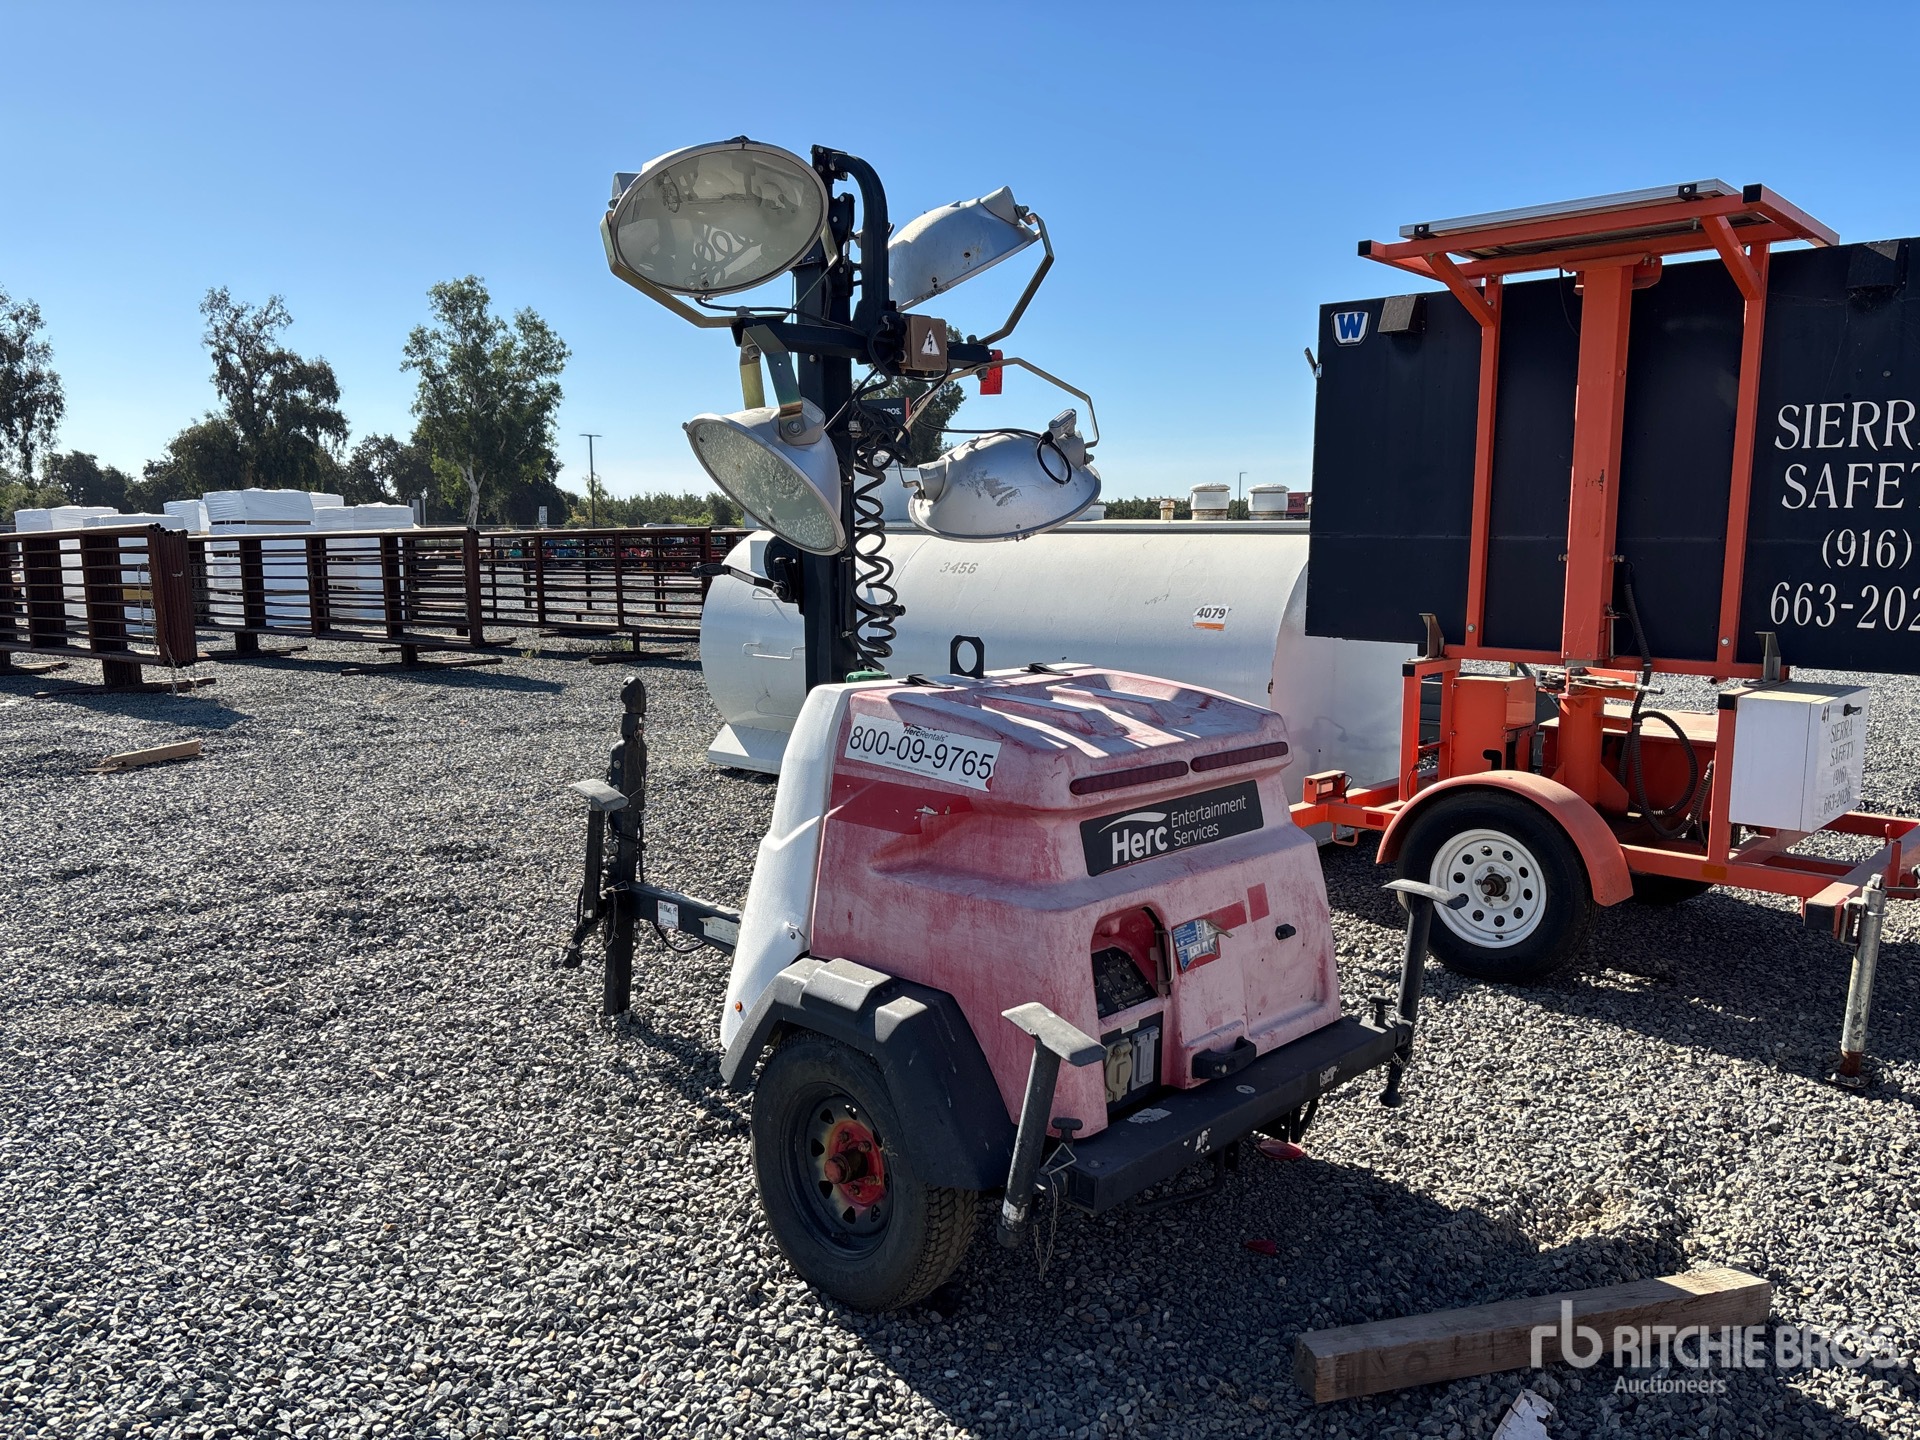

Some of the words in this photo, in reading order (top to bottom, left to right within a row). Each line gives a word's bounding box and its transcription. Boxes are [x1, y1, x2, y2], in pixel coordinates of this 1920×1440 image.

[1337, 312, 1365, 339] W
[1774, 400, 1920, 451] SIERR
[1822, 528, 1912, 569] (916)
[939, 561, 979, 574] 3456
[1196, 607, 1226, 619] 4079
[1830, 718, 1853, 743] SIERRA
[849, 725, 994, 780] 800-09-9765
[1829, 740, 1855, 767] SAFETY
[1823, 786, 1851, 815] 663-2026
[1111, 825, 1168, 865] Herc
[1171, 794, 1247, 829] Entertainment
[1173, 823, 1220, 847] Services
